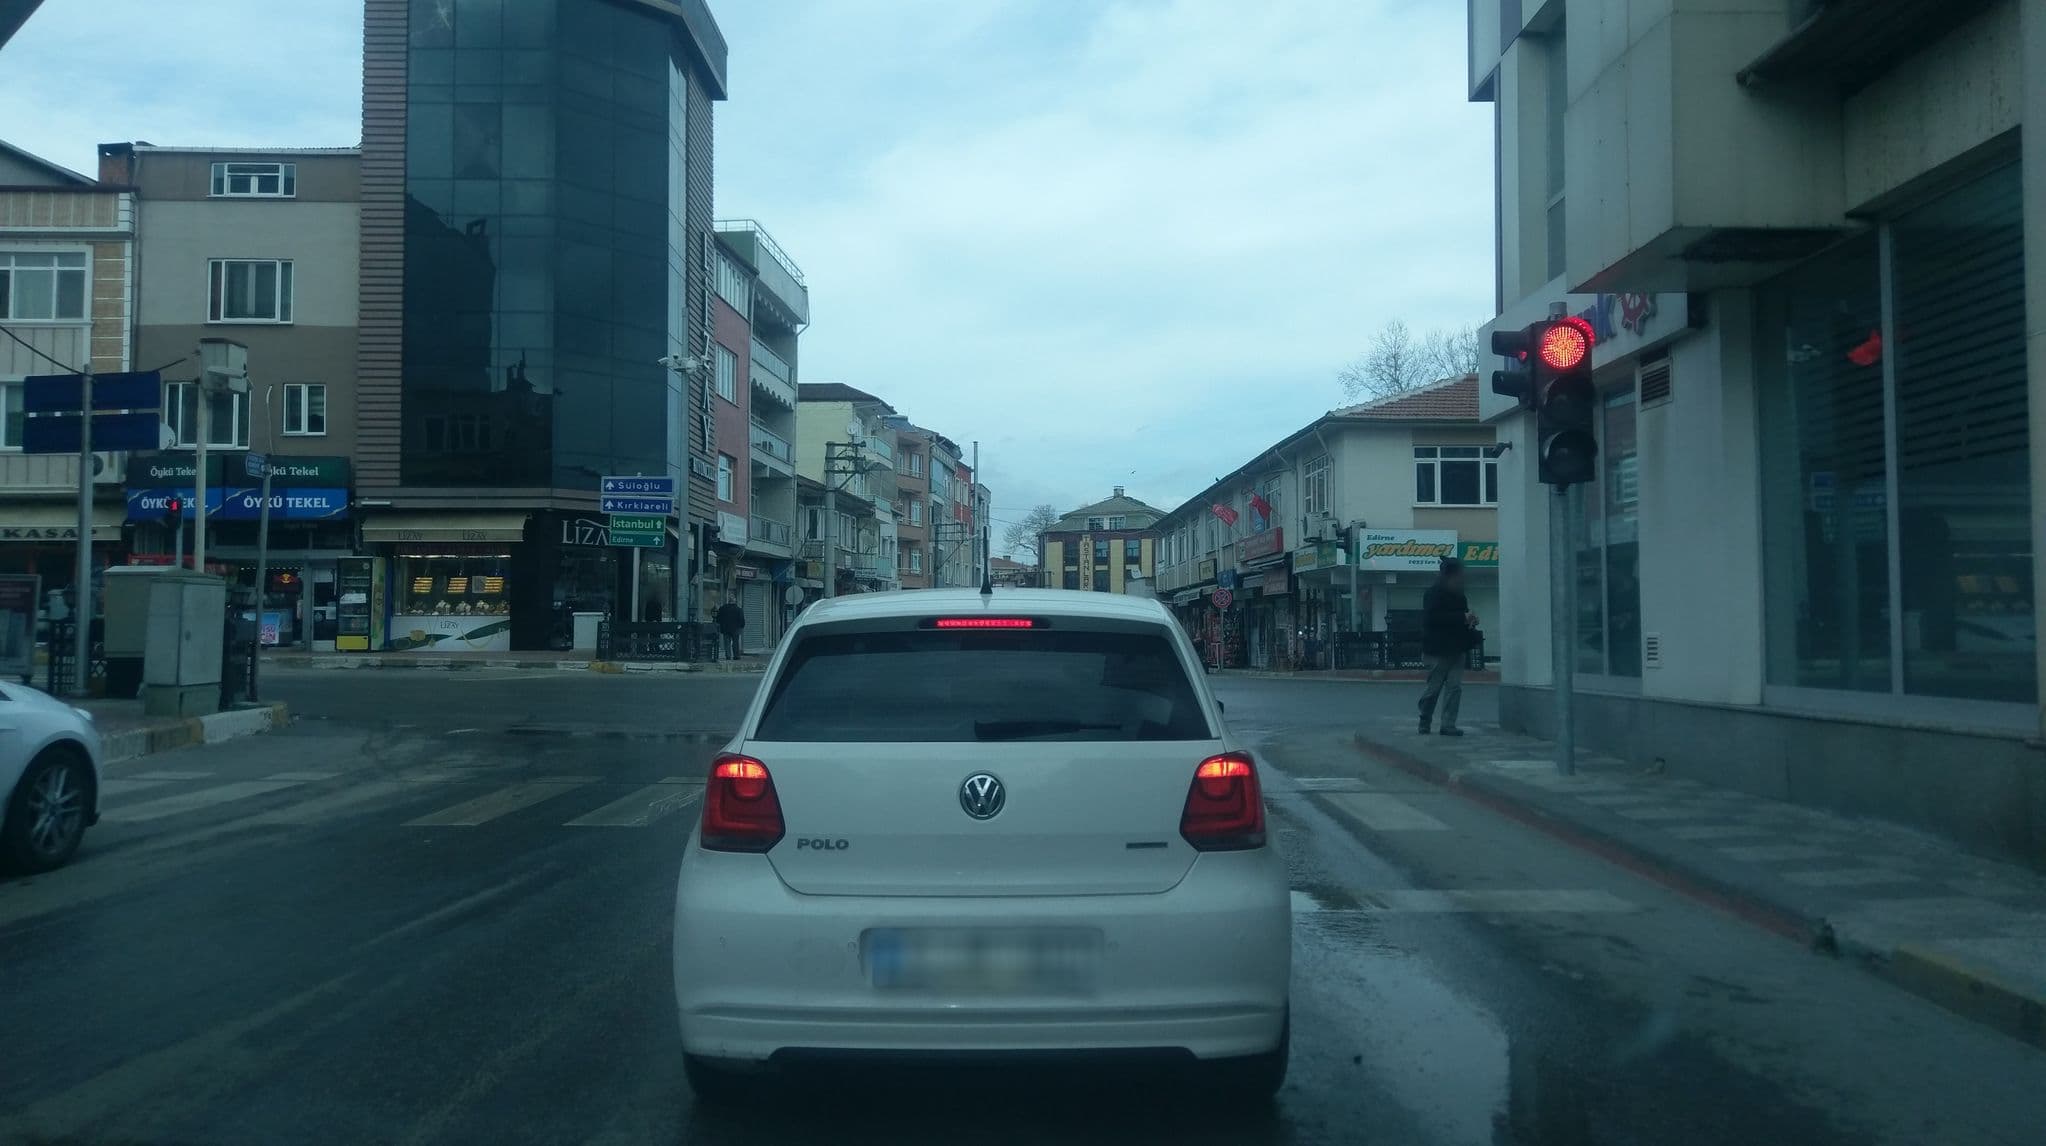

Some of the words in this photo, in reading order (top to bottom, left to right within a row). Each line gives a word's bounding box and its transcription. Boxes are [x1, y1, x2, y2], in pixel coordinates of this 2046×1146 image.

[150, 466, 174, 478] Öykü
[176, 467, 197, 476] Teke
[289, 466, 319, 476] Tekel
[618, 481, 660, 491] Süloğlu
[243, 495, 283, 508] ÖYKÜ
[286, 497, 330, 508] TEKEL
[617, 501, 669, 511] Kırklareli
[612, 516, 654, 529] İstanbul
[561, 518, 611, 546] LİZA
[611, 535, 634, 544] Edirne
[797, 838, 850, 850] POLO
